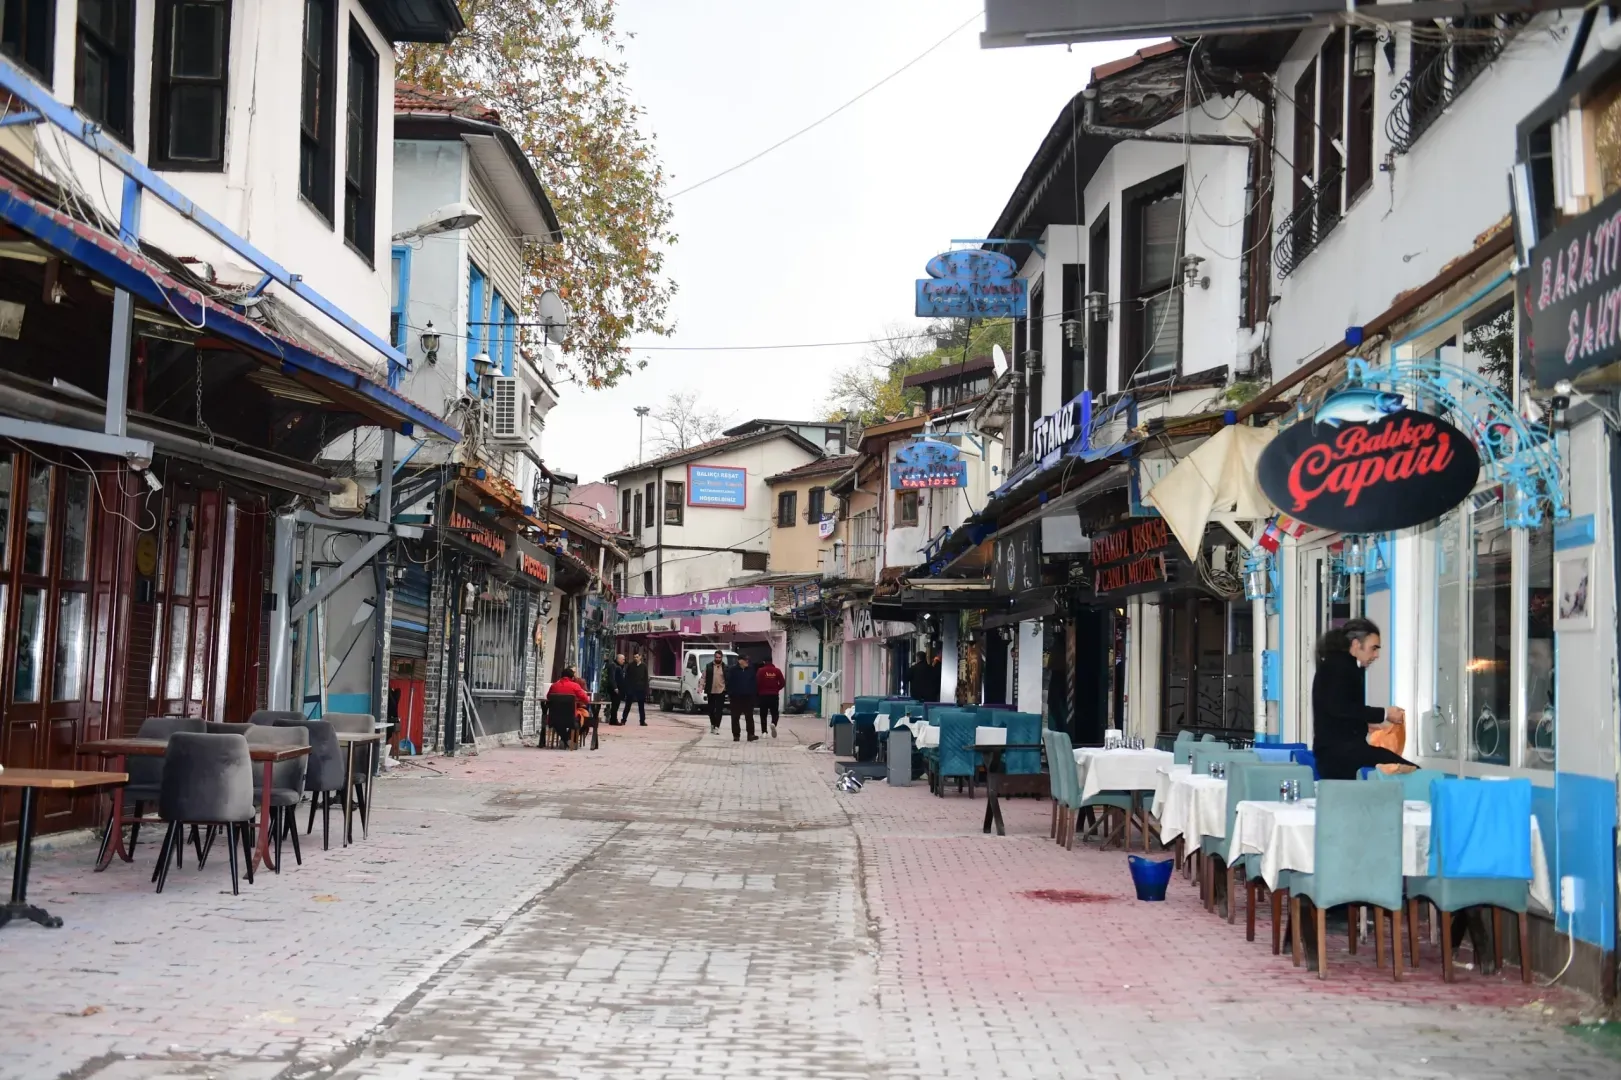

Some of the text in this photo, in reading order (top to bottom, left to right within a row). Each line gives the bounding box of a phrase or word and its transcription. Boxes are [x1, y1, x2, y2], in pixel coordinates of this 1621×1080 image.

[1331, 417, 1436, 461] Balıkçı
[1287, 432, 1454, 512] Çapari
[1131, 519, 1169, 552] BURSA
[523, 554, 547, 584] PICCOLO
